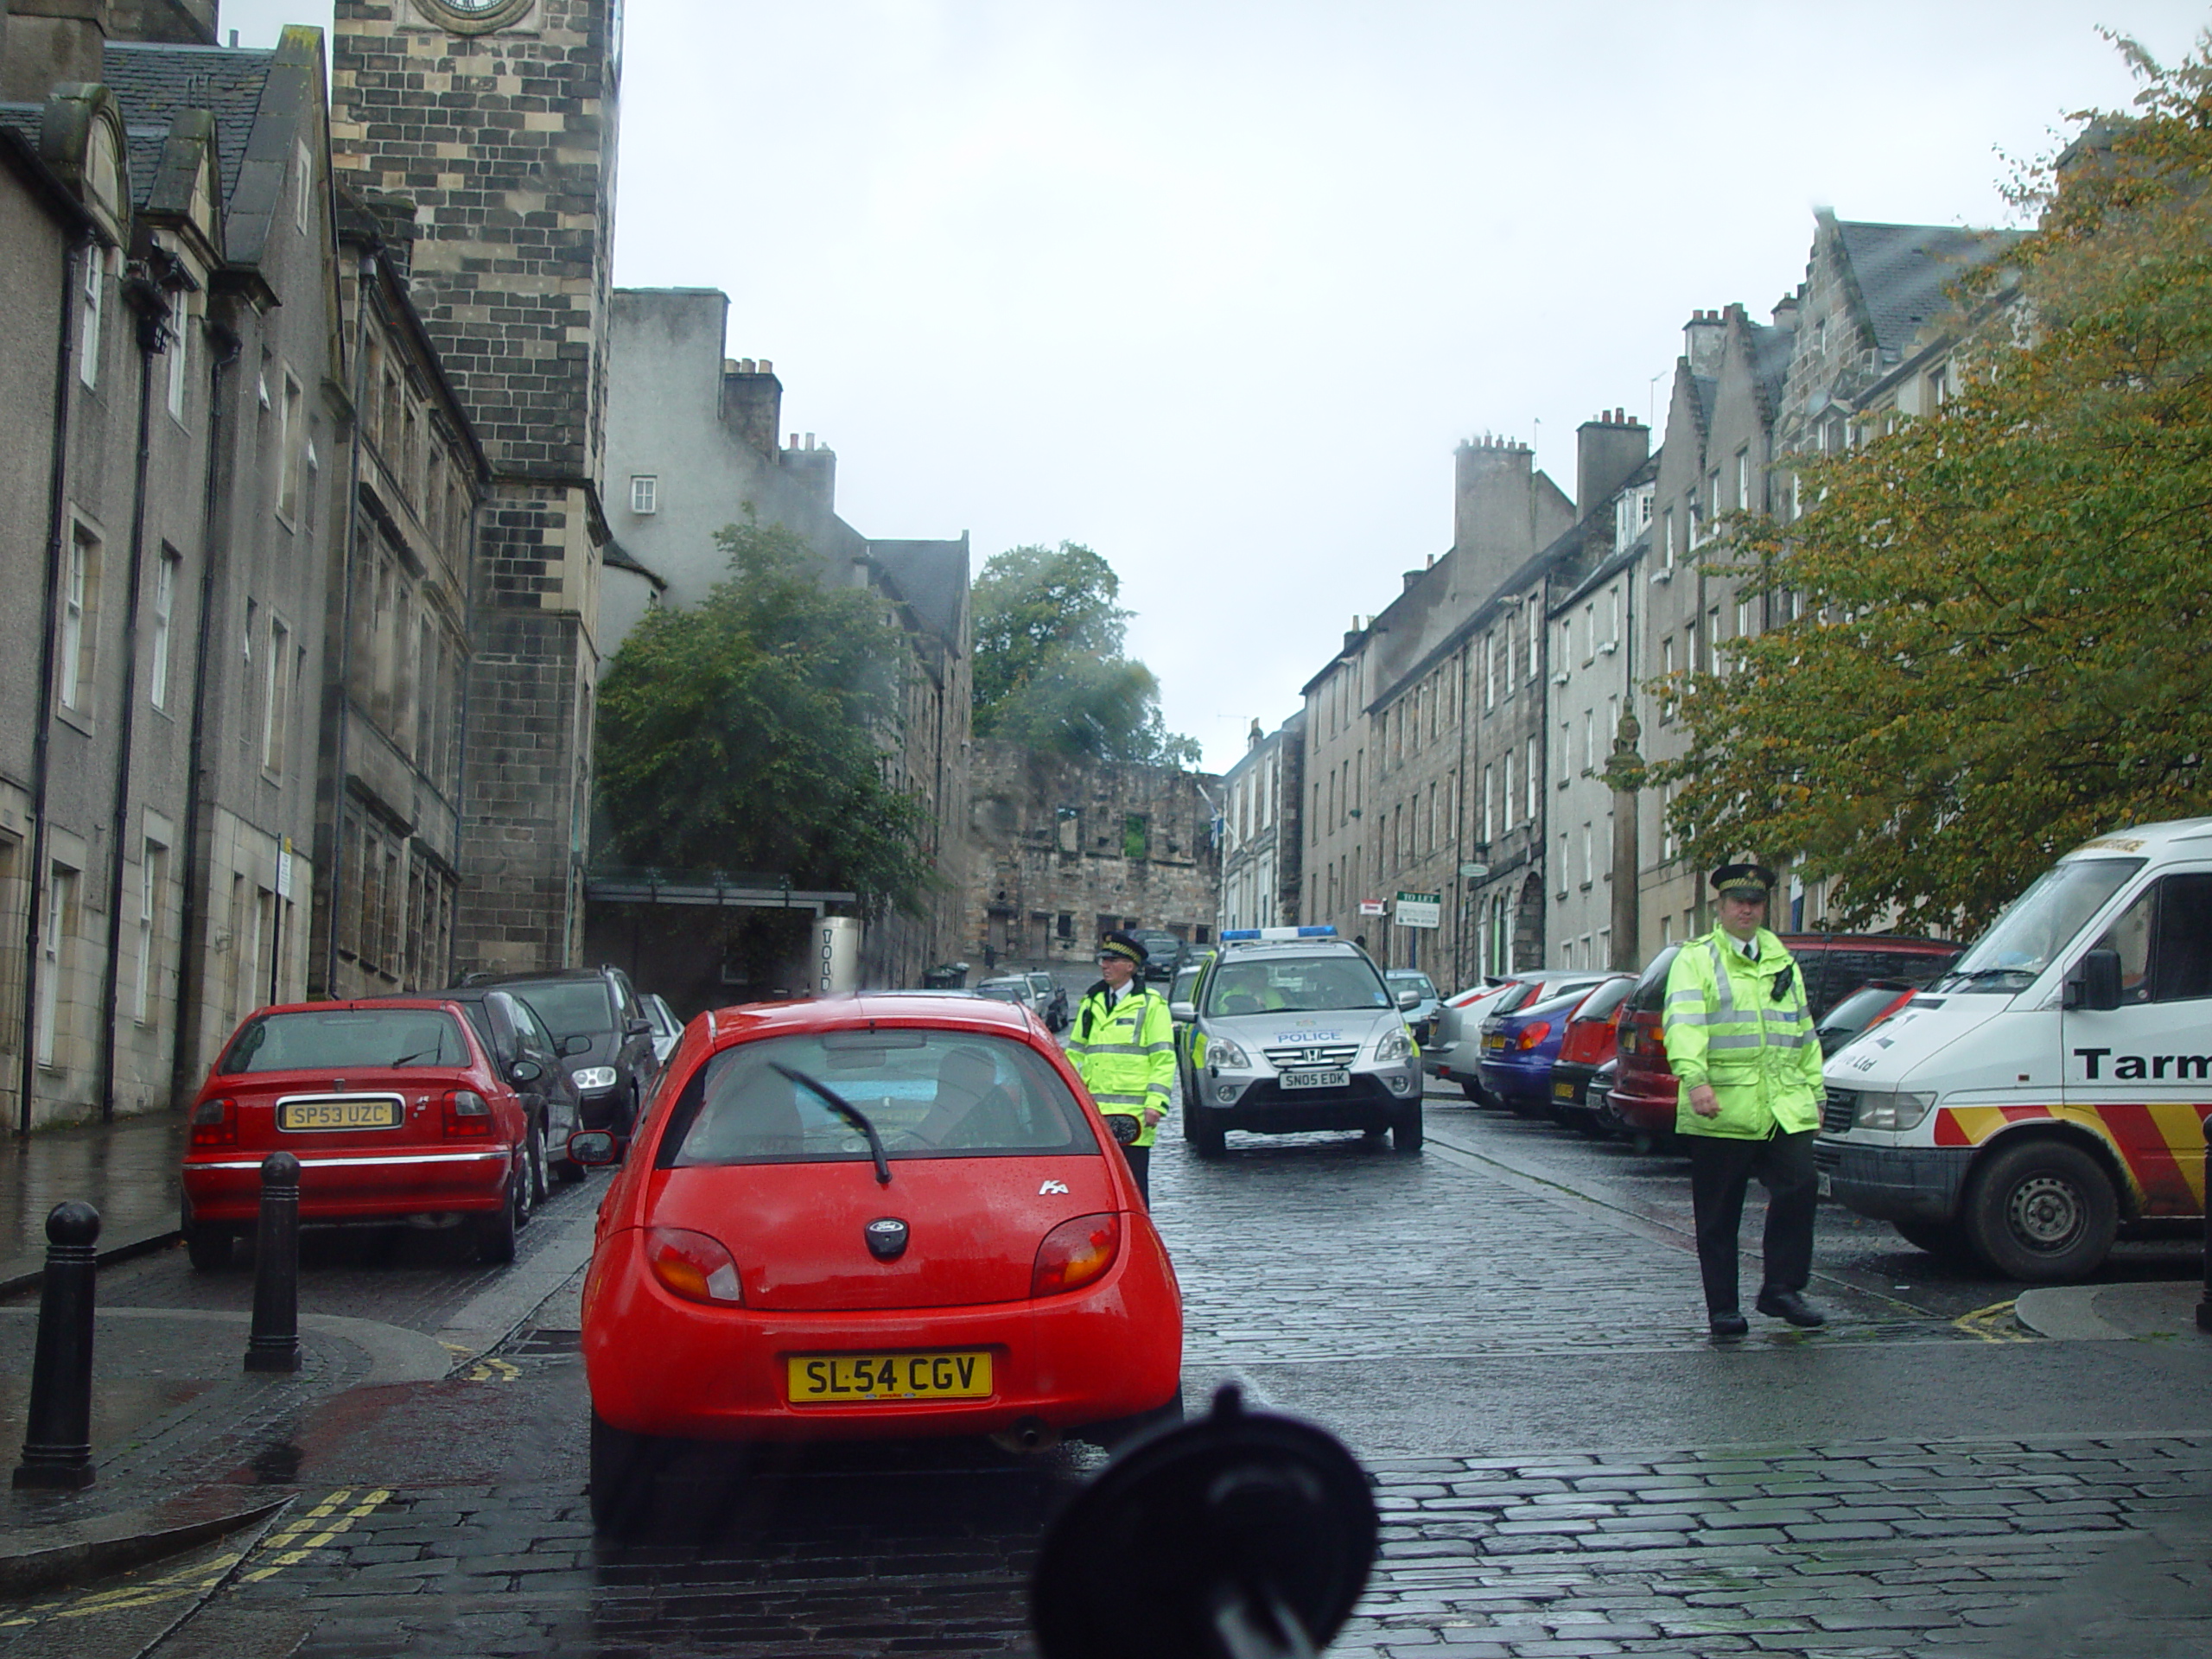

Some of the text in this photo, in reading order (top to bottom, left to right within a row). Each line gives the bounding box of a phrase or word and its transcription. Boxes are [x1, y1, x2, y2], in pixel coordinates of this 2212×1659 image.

[1403, 893, 1435, 903] TO LET
[1278, 1031, 1342, 1044] POLICE
[1853, 1055, 1878, 1072] Ltd
[1286, 1071, 1345, 1087] SN05 EDK
[294, 1105, 385, 1123] SP53 UZC
[806, 1357, 976, 1394] SL54 CGV
